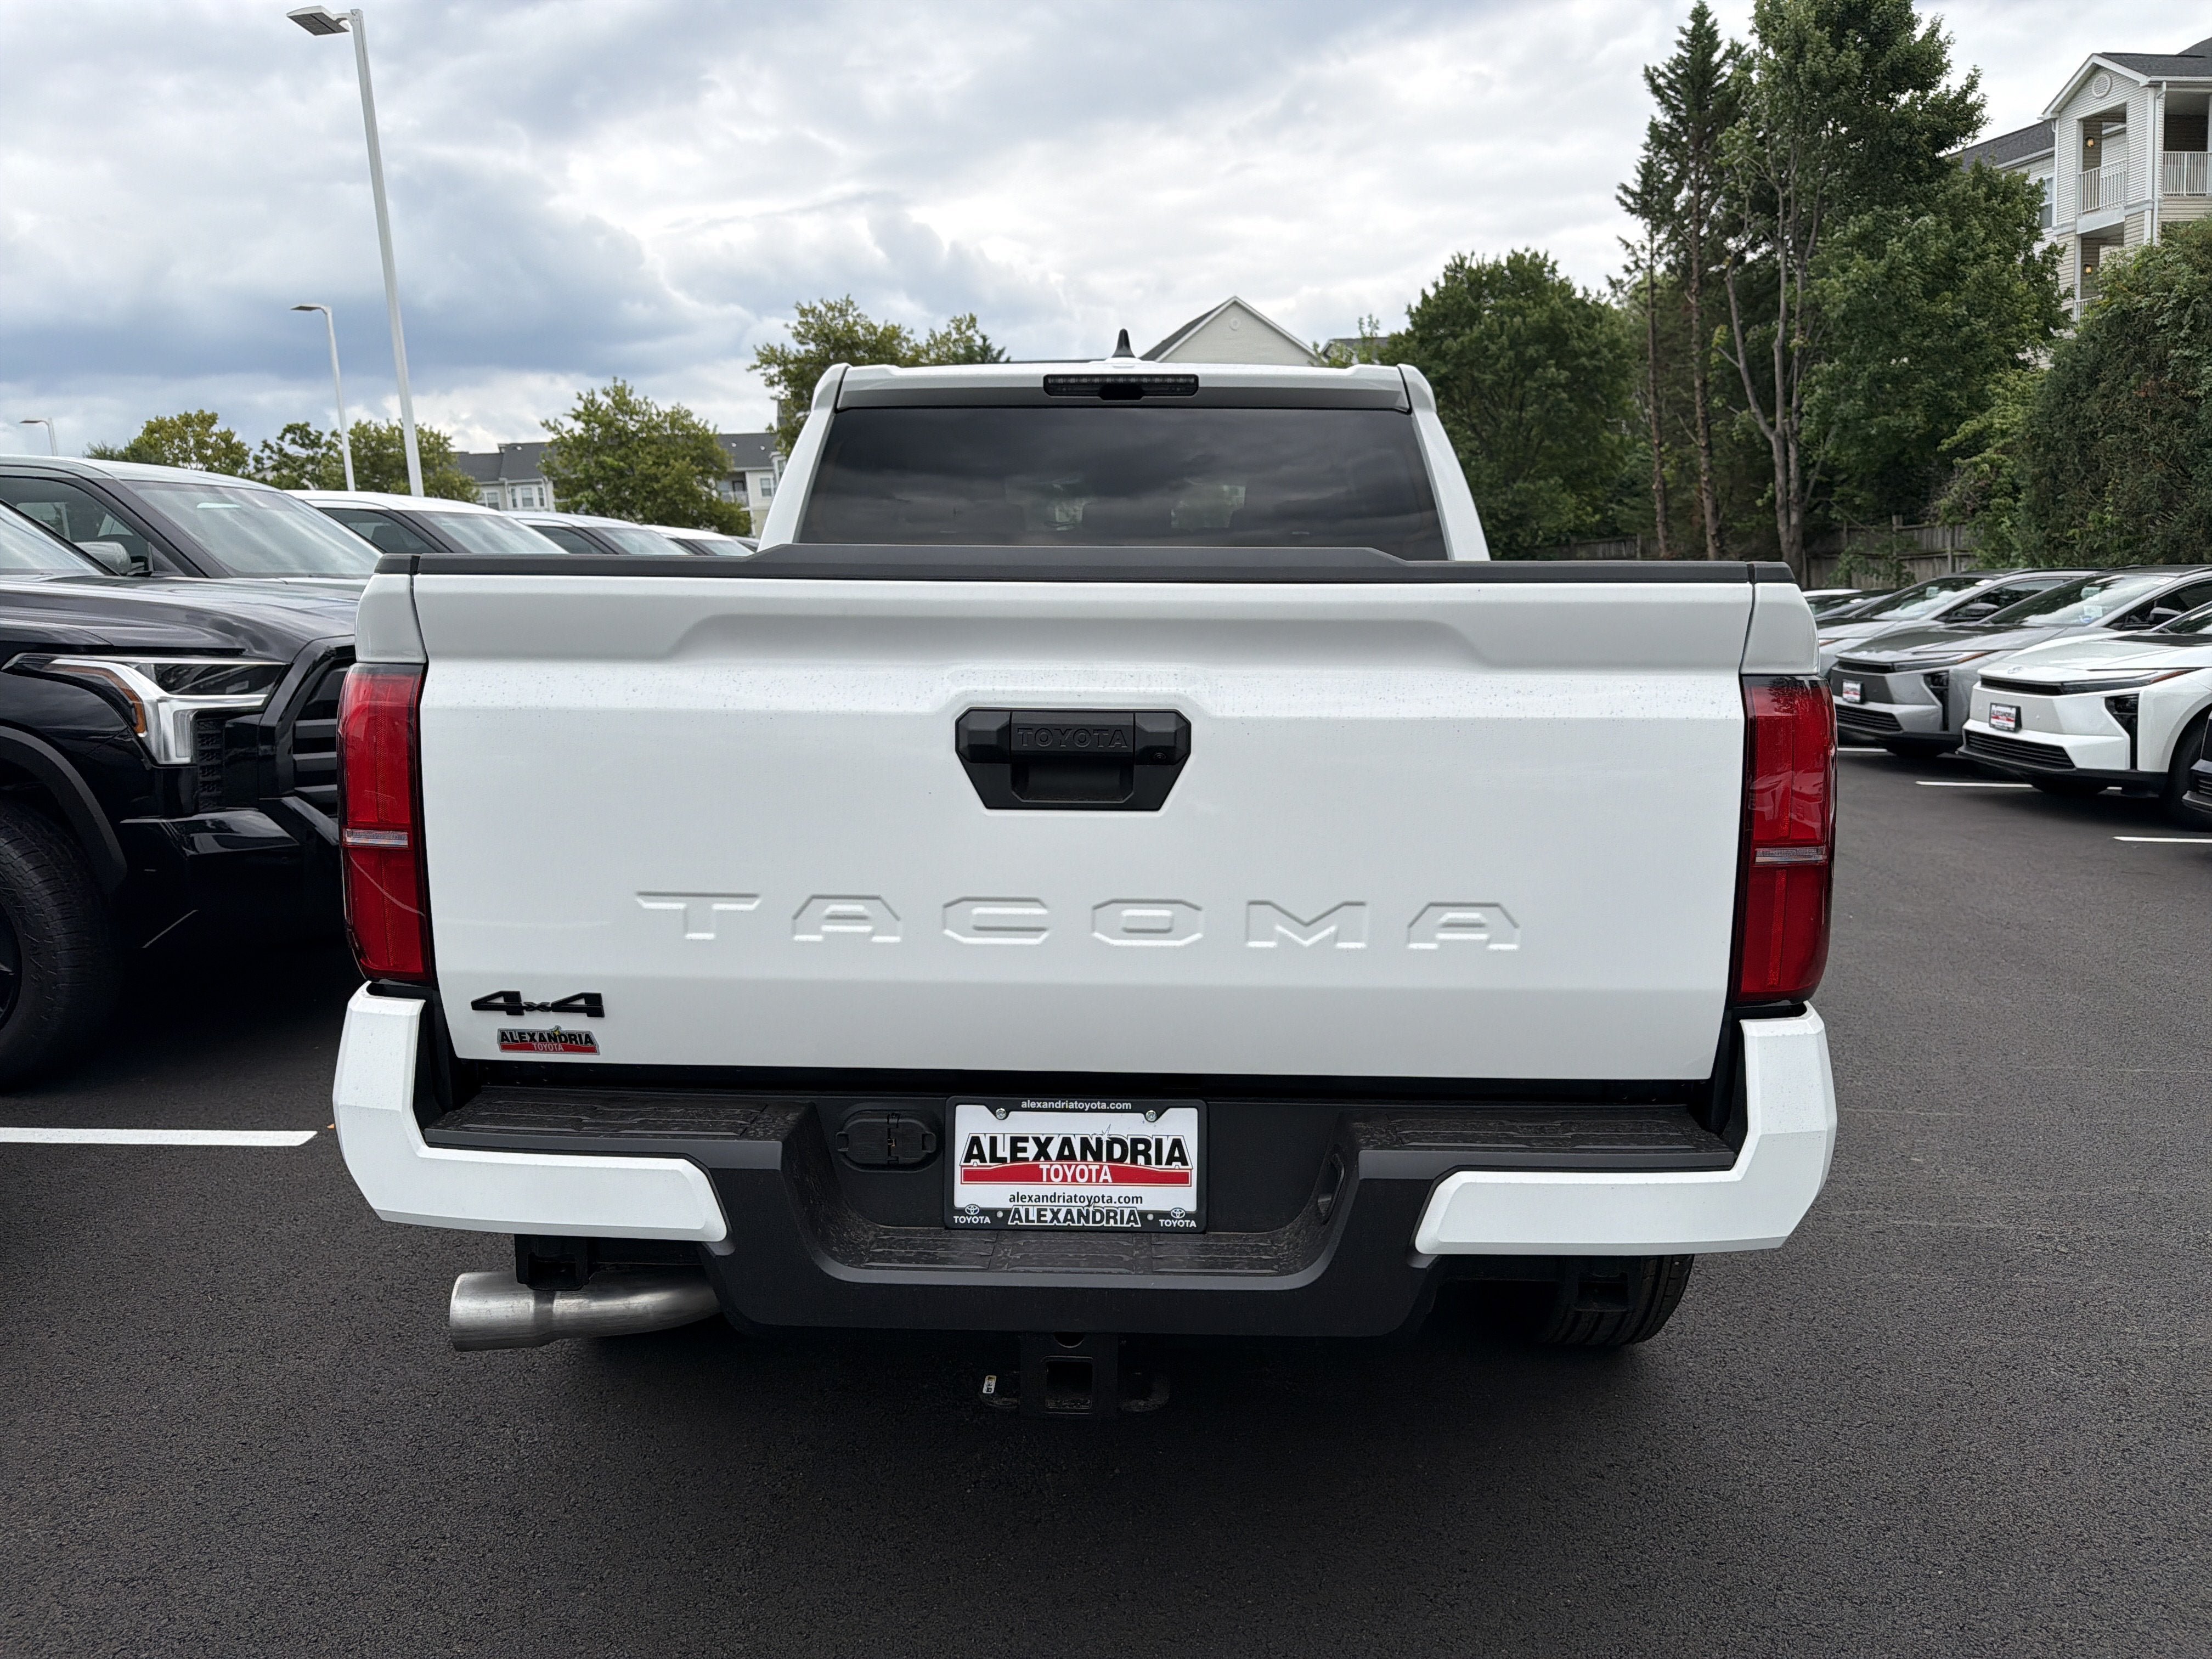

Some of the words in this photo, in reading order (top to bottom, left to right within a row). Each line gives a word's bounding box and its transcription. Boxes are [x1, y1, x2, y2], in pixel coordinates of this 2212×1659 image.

[1017, 727, 1128, 748] TOYOTA
[635, 890, 1521, 950] TACOMA
[500, 1030, 596, 1046] ALEXANDRIA
[532, 1043, 565, 1052] TOYOTA
[1021, 1099, 1132, 1111] alexandriatoyota.com
[962, 1134, 1190, 1168] ALEXANDRIA
[1039, 1164, 1113, 1183] TOYOTA
[1009, 1192, 1143, 1205] alexandriatoyota.com
[953, 1215, 991, 1224] TOYOTA
[1008, 1205, 1141, 1227] ALEXANDRIA
[1159, 1218, 1197, 1228] TOYOTA
